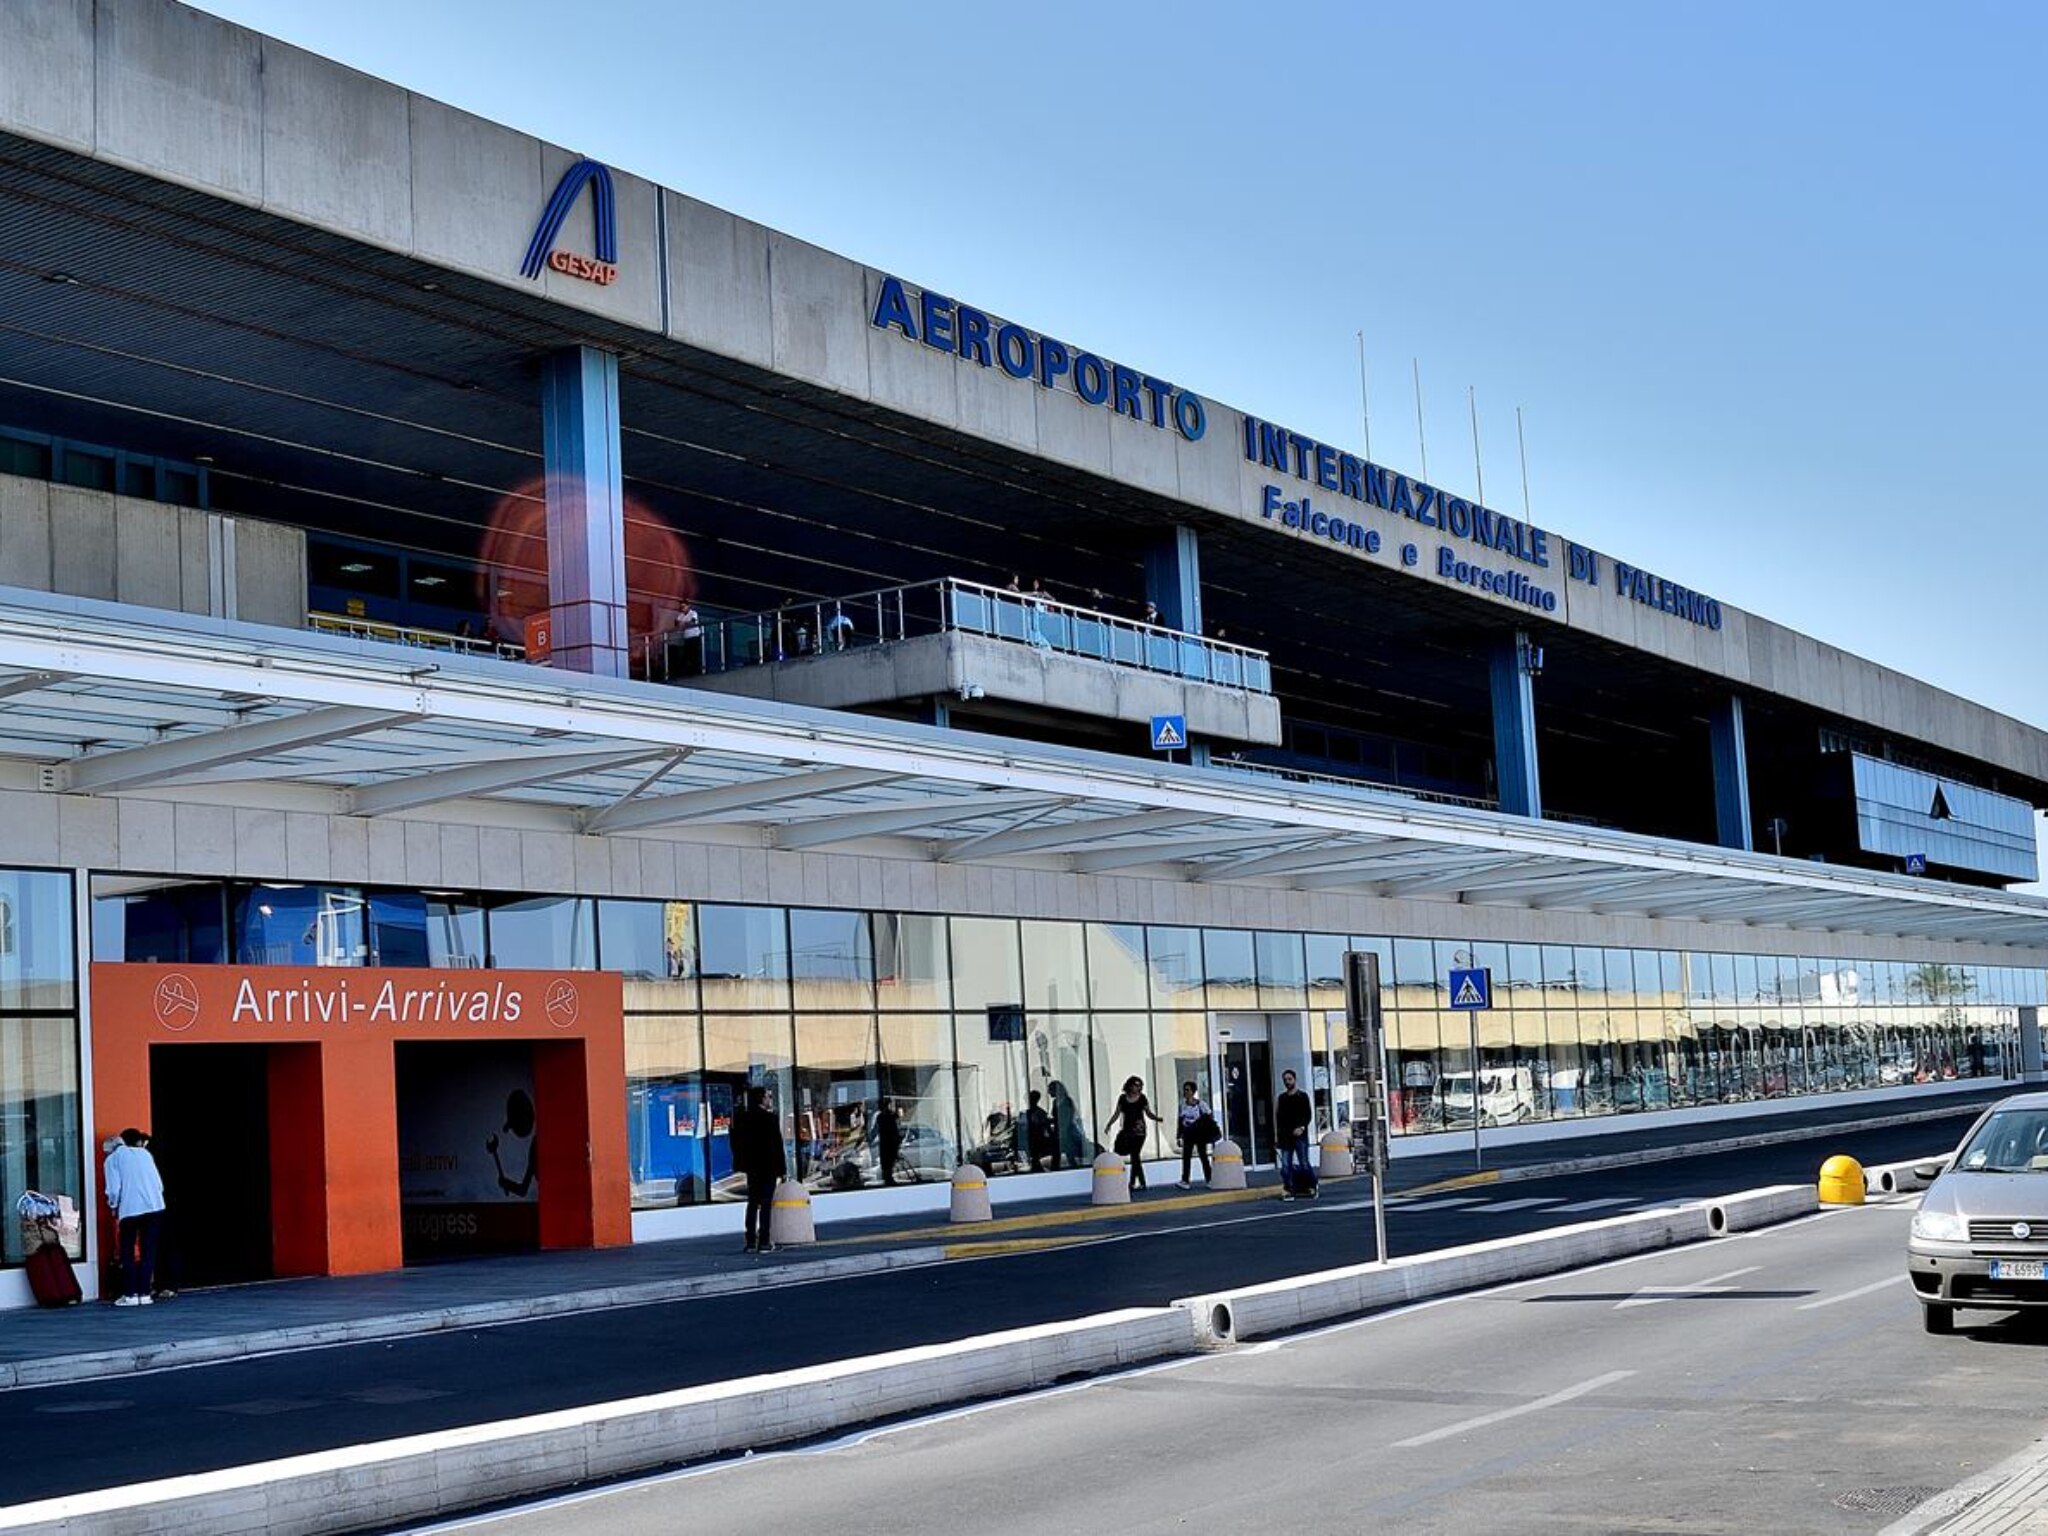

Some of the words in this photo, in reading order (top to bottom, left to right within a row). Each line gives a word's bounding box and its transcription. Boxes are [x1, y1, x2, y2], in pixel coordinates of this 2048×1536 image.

[547, 250, 618, 286] GESAP
[871, 275, 1206, 441] AEROPORTO
[1244, 415, 1549, 568] INTERNAZIONALE
[1569, 542, 1599, 585] DI
[1616, 562, 1723, 630] PALERMO
[1261, 484, 1381, 553] Falcone
[1402, 543, 1418, 566] e
[1438, 546, 1557, 612] Borsellino
[231, 978, 522, 1022] Arrivi-Arrivals
